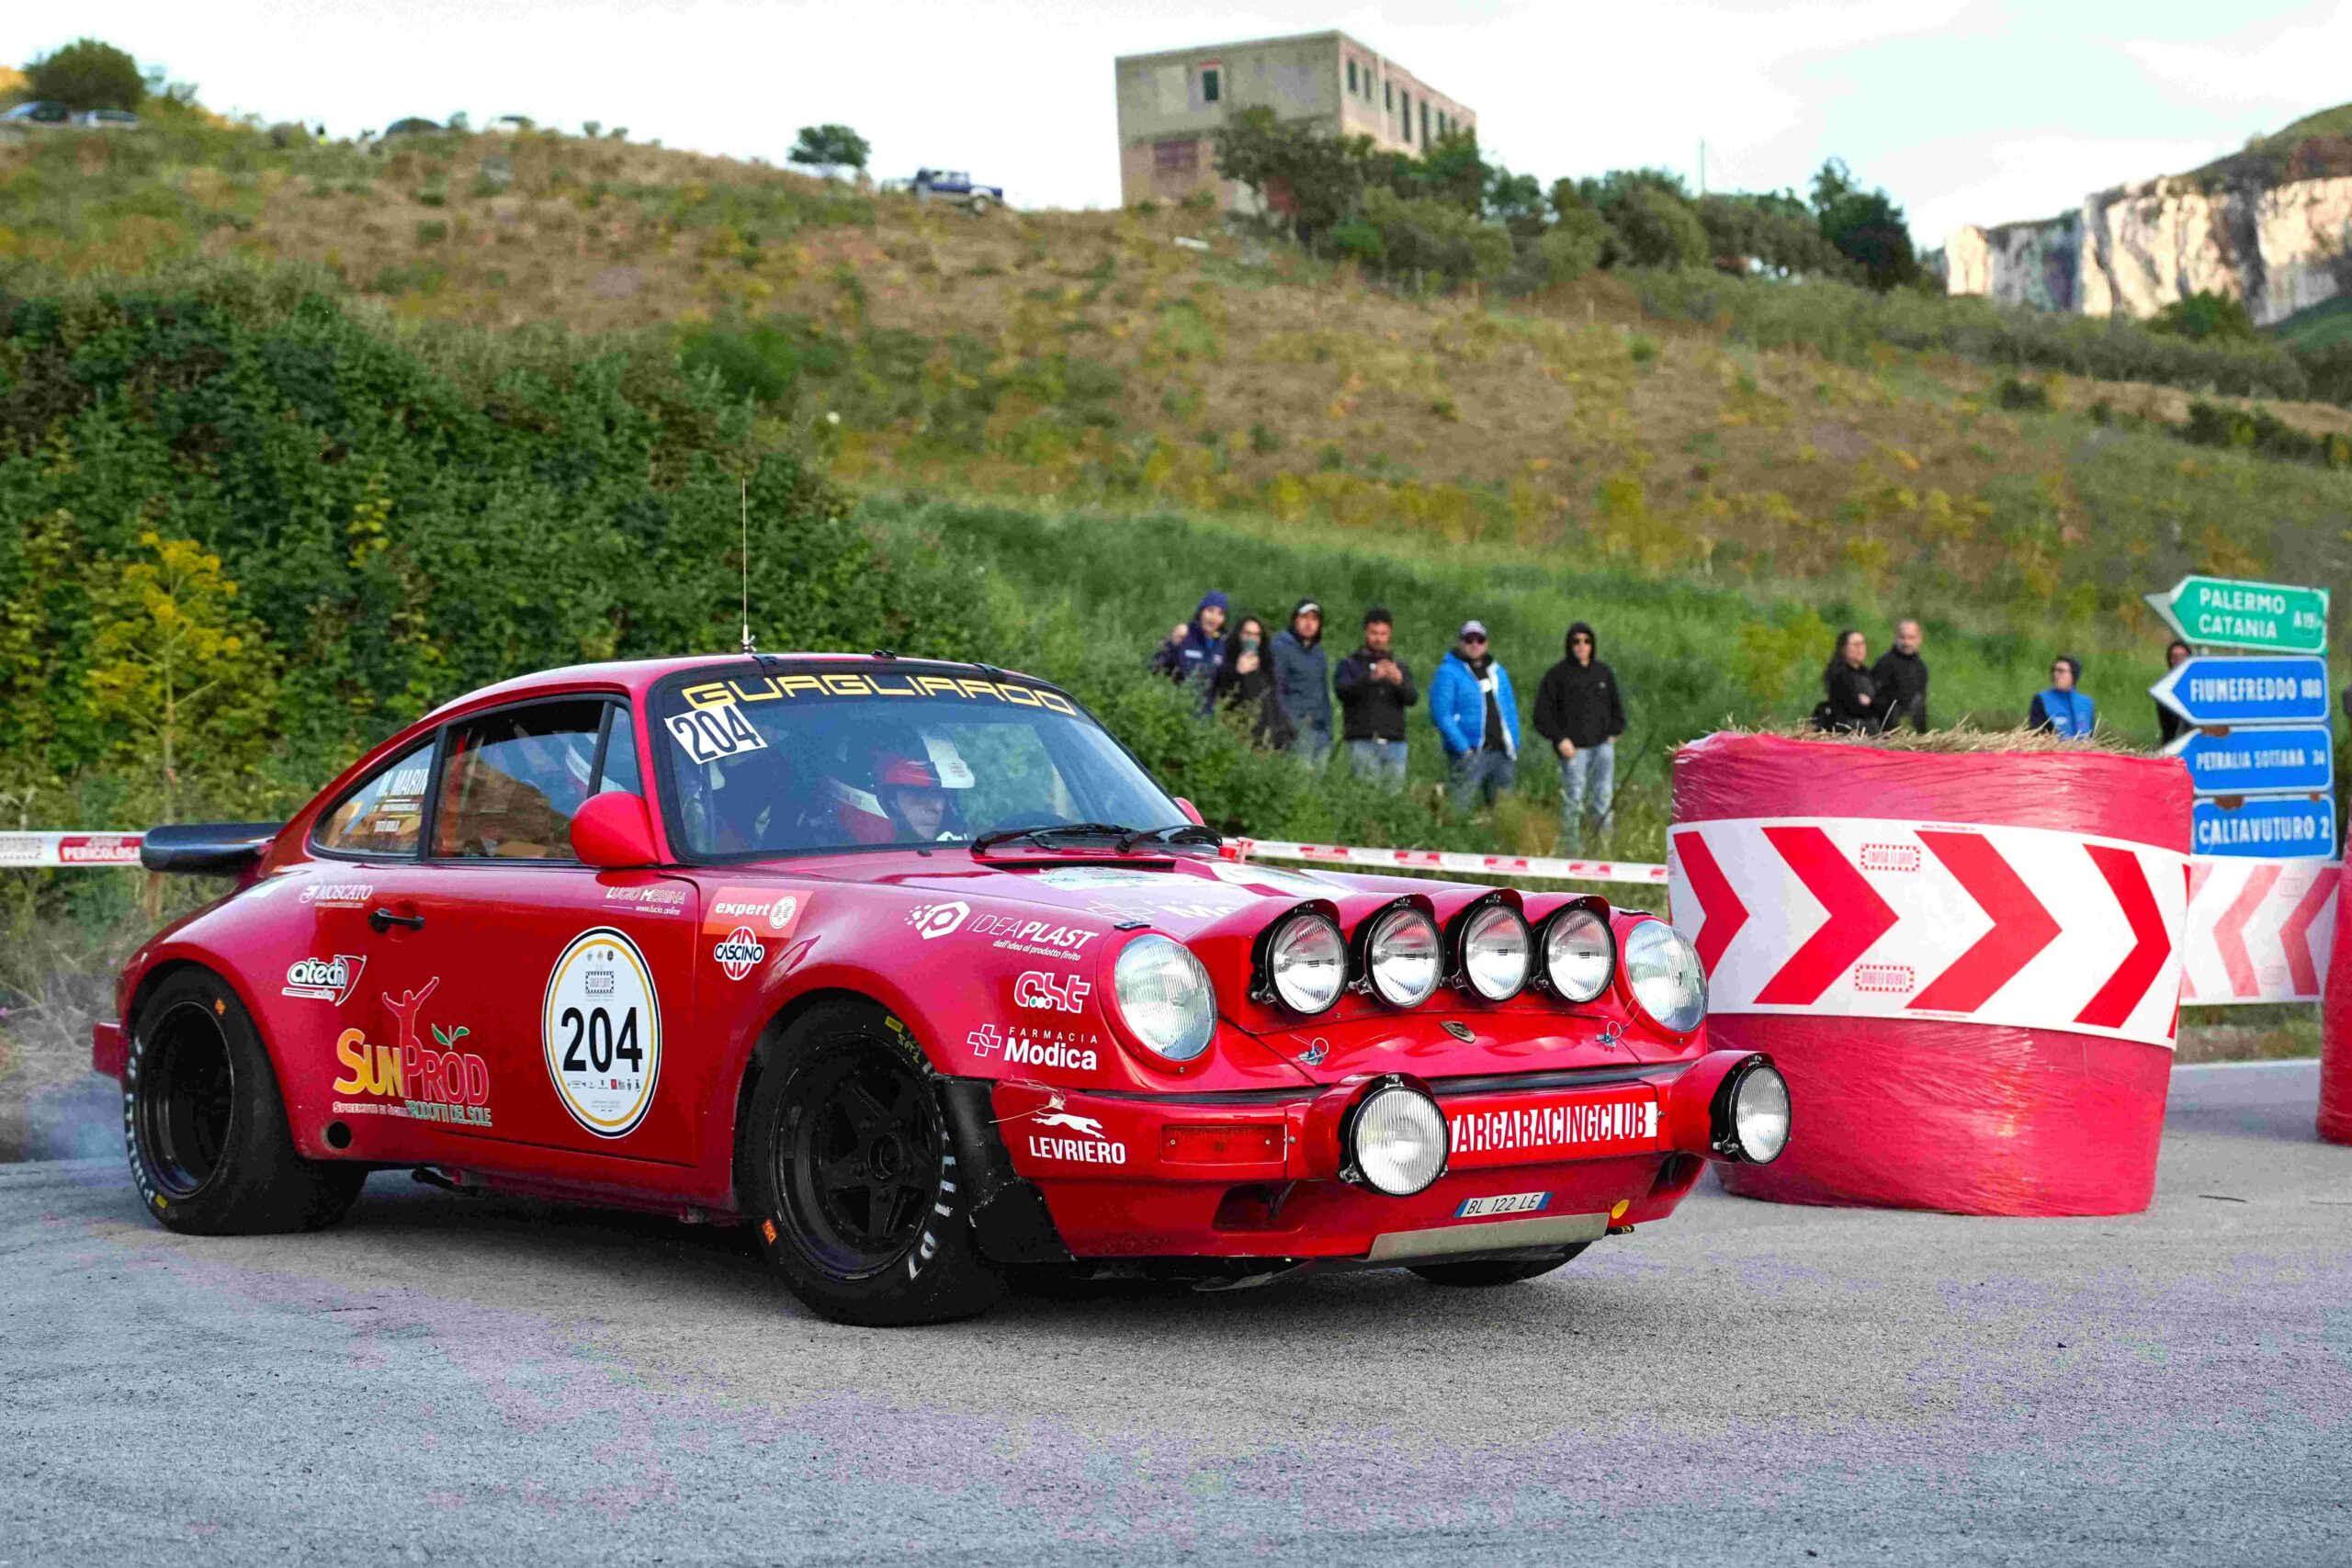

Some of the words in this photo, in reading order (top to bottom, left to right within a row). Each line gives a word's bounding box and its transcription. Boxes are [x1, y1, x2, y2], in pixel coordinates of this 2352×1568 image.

[2199, 587, 2286, 615] PALERMO
[2198, 614, 2278, 638] CATANIA
[682, 674, 1077, 716] GUAGLIARDO
[2190, 677, 2297, 702] FIUMEFREDDO
[673, 706, 760, 760] 204
[2199, 817, 2314, 845] CALTAVUTURO
[2320, 818, 2331, 840] 2
[315, 885, 374, 900] MOSCATO
[606, 887, 640, 900] LUCIO
[640, 889, 686, 905] MESSINA
[716, 900, 770, 918] expert
[967, 913, 1099, 950] IDEAPLAST
[716, 945, 763, 962] CASCINO
[1030, 946, 1061, 958] prodotto
[1060, 950, 1081, 961] finito
[289, 955, 345, 986] atech
[561, 1007, 642, 1073] 204
[1009, 1026, 1097, 1043] FARMACIA
[1004, 1037, 1097, 1070] Modica
[1029, 1135, 1126, 1165] LEVRIERO
[1466, 1198, 1482, 1214] BL
[1490, 1196, 1517, 1213] 122
[1518, 1194, 1538, 1210] LE
